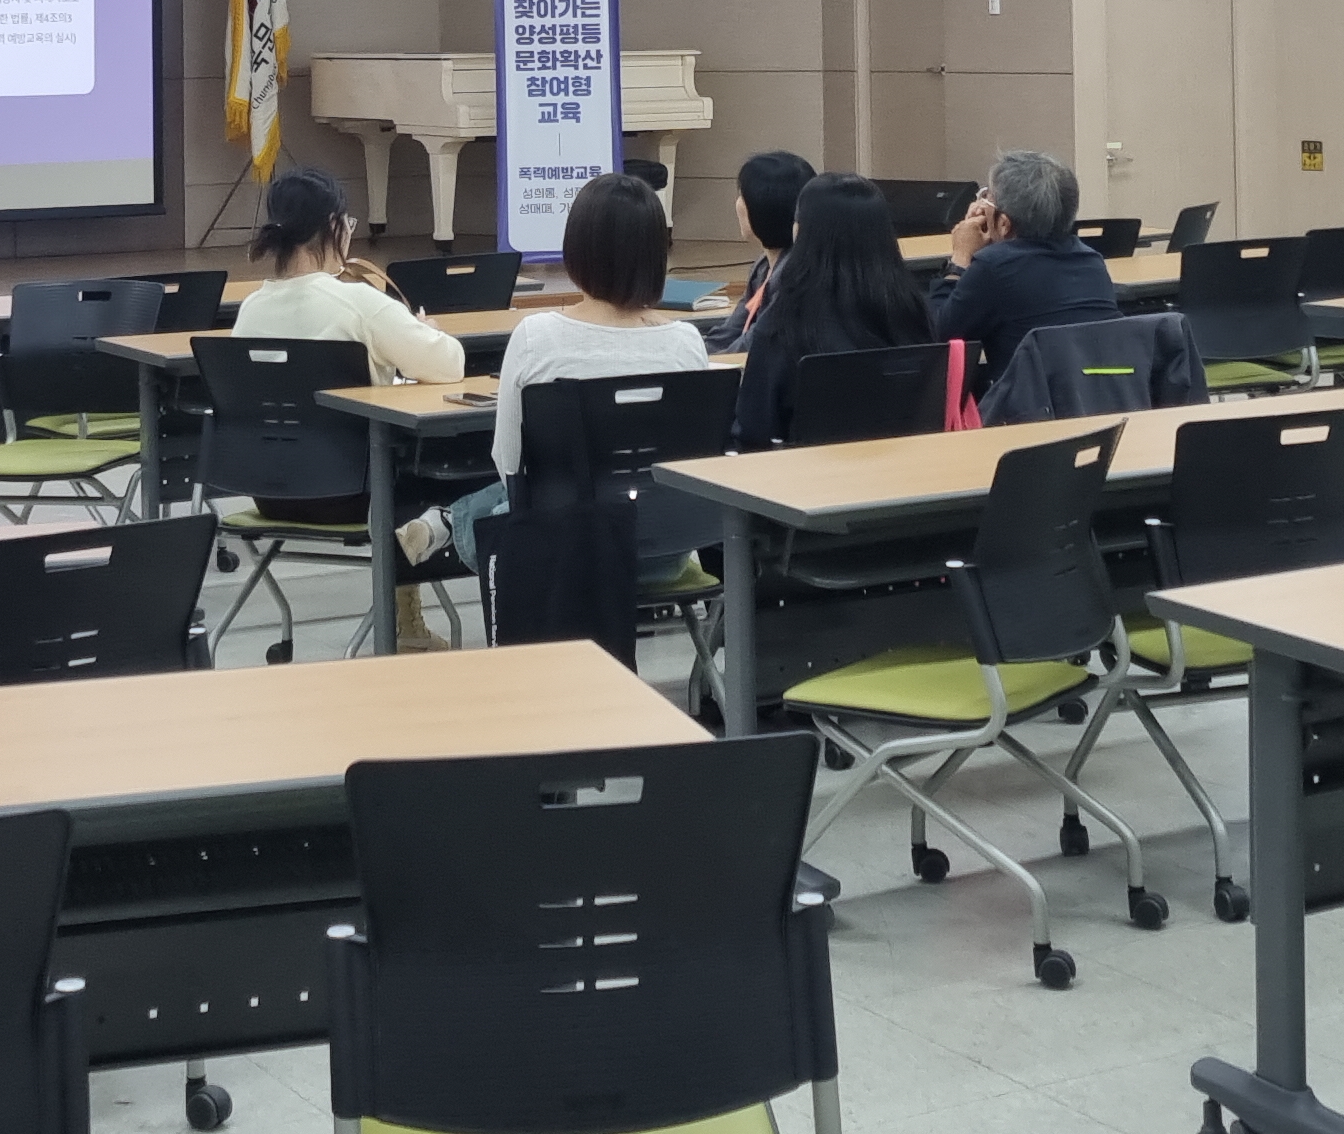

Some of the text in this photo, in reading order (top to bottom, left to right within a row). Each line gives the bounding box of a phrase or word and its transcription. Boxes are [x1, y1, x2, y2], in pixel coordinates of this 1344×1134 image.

[514, 23, 602, 46] 양성평등
[514, 48, 603, 72] 문화확산
[526, 75, 592, 98] 참여형
[537, 101, 582, 124] 교육
[518, 165, 603, 181] 폭력예방교육
